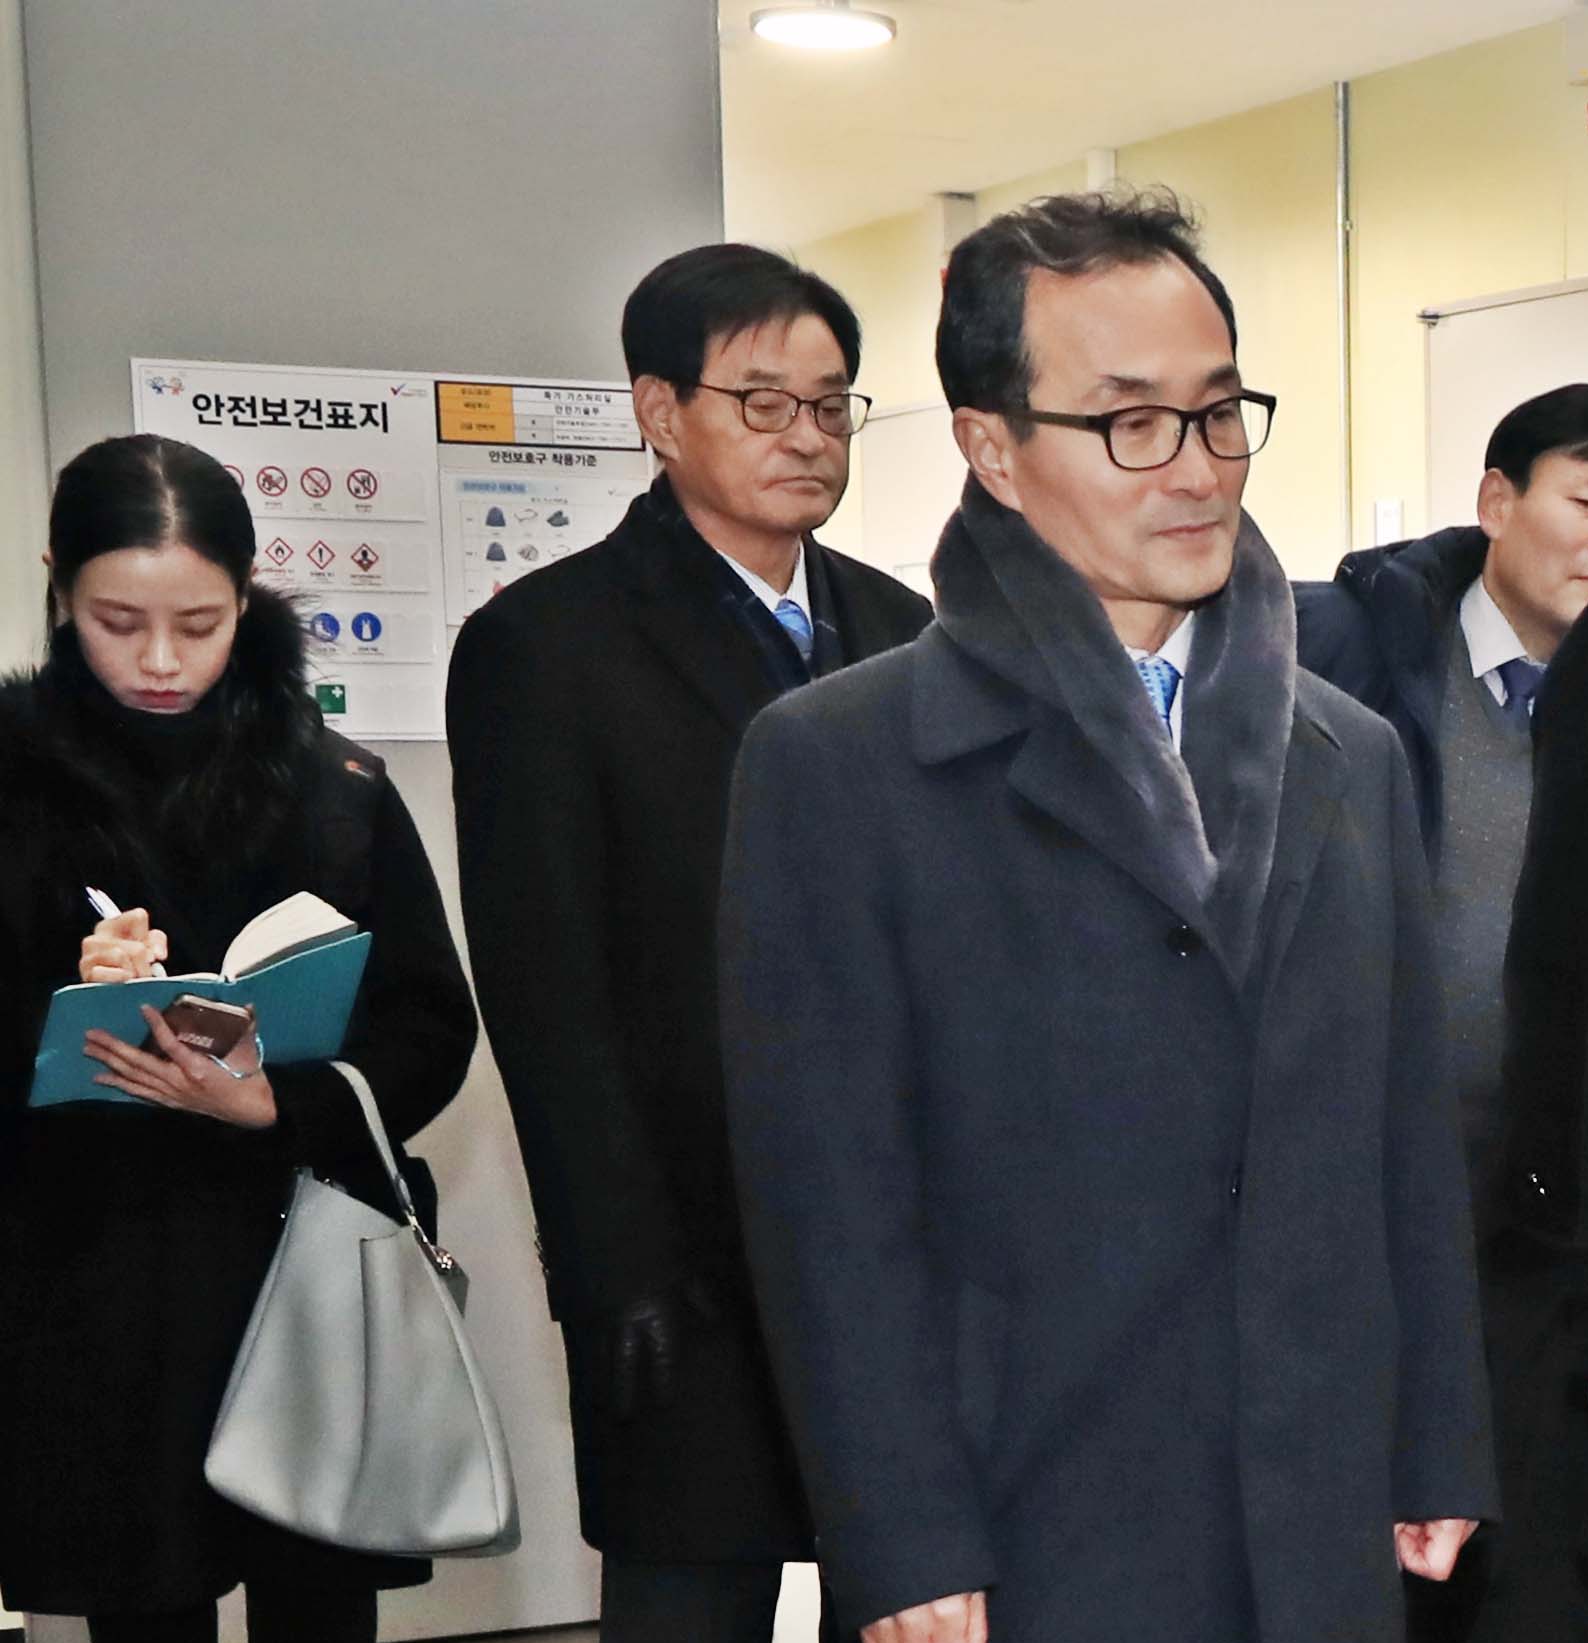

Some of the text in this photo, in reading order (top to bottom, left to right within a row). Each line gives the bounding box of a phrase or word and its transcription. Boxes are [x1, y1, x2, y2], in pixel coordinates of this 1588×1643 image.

[191, 392, 389, 433] 안전보건표지
[488, 450, 598, 467] 안전보호구 착용기준
